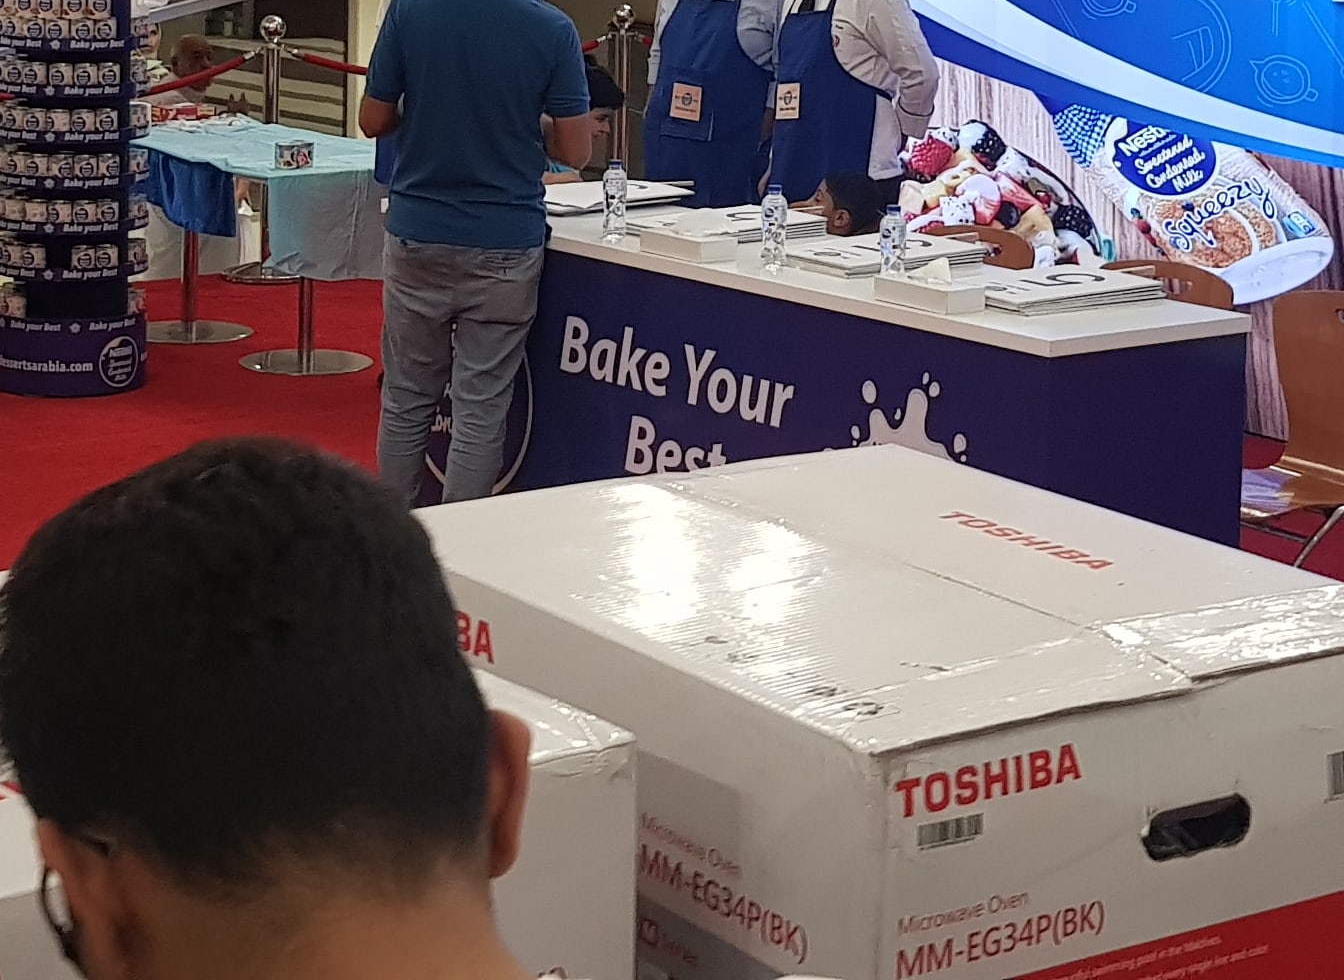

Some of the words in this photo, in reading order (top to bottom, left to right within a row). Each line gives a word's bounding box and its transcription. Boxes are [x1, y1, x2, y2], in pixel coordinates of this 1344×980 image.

[70, 40, 90, 48] Bake
[90, 41, 109, 50] your
[64, 86, 84, 94] Bake
[85, 87, 103, 96] your
[64, 132, 84, 140] Bake
[85, 133, 103, 142] your
[1134, 133, 1193, 174] Sweetened
[63, 179, 83, 187] Bake
[84, 180, 102, 188] your
[1145, 149, 1206, 189] Condensed
[1172, 170, 1204, 192] Milk
[63, 224, 83, 232] Bake
[84, 225, 102, 234] your
[1163, 175, 1278, 253] Squeezy
[62, 270, 83, 278] Bake
[83, 271, 101, 280] your
[559, 315, 671, 398] Bake
[683, 343, 796, 428] Your
[624, 414, 728, 475] Best
[939, 511, 1114, 570] TOSHIBA
[894, 743, 1083, 819] TOSHIBA
[639, 843, 810, 965] MM-EG34P(BK)
[896, 903, 986, 935] Microwave
[987, 892, 1029, 914] Oven
[894, 900, 1106, 980] MM-EG34P(BK)
